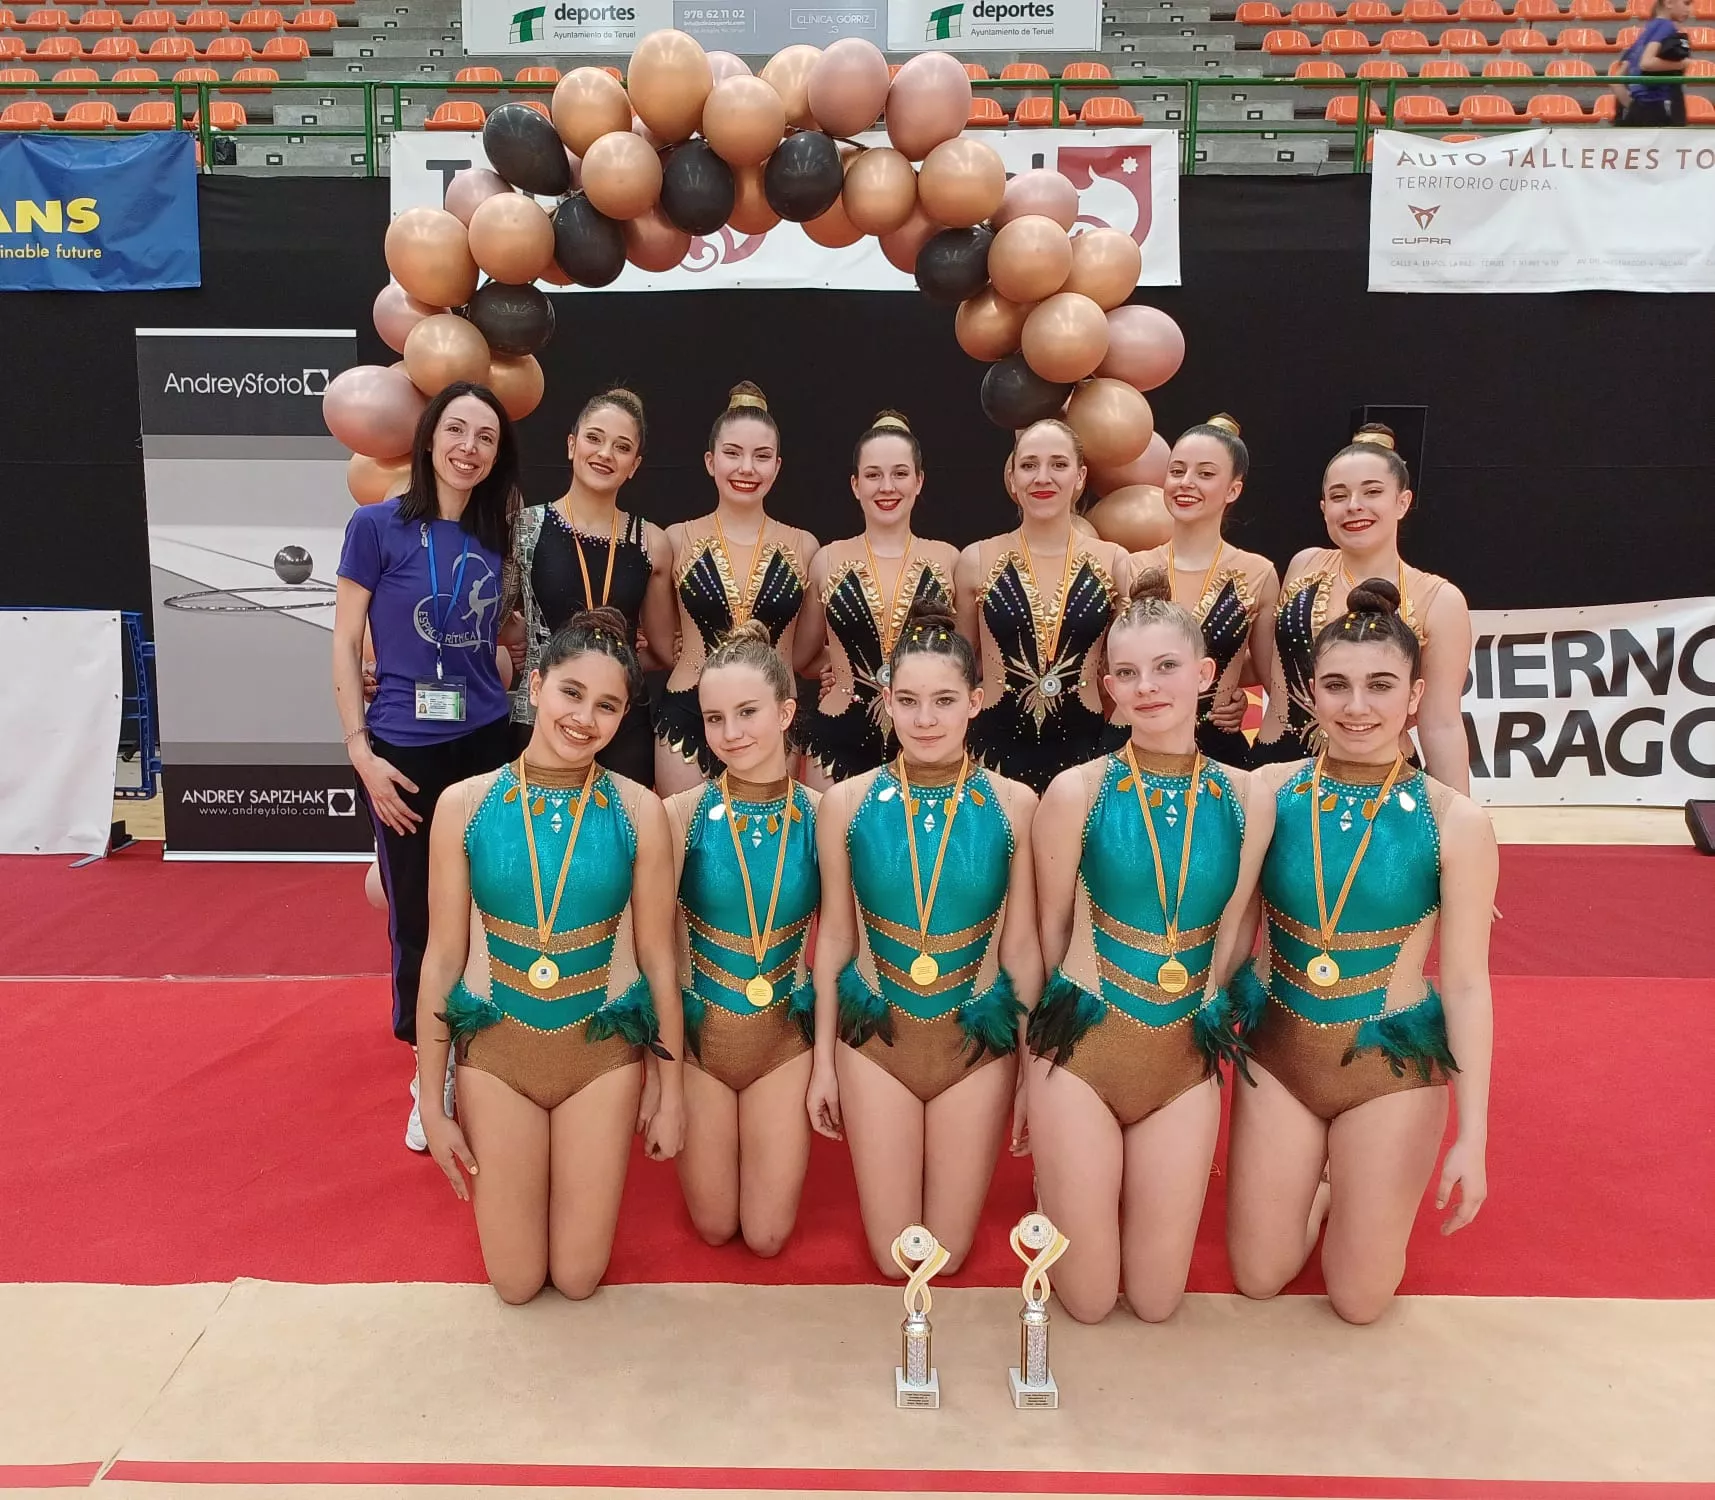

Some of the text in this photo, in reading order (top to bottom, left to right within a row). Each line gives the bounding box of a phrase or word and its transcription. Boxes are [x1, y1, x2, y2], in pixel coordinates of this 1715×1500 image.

[554, 3, 636, 25] deportes
[683, 9, 746, 19] 978 62 11 02
[972, 0, 1054, 22] deportes
[553, 30, 636, 40] Ayuntamiento de Teruel
[970, 27, 1055, 37] Ayuntamiento de Teruel
[1396, 150, 1487, 167] AUTO
[1501, 146, 1660, 170] TALLERES
[1395, 175, 1494, 191] TERRITORIO
[1391, 236, 1452, 245] CUPRA
[56, 243, 102, 259] future
[164, 372, 303, 398] AndreySfoto
[181, 789, 325, 804] ANDREY SAPIZHAK
[198, 804, 325, 818] www.andreysfoto.com
